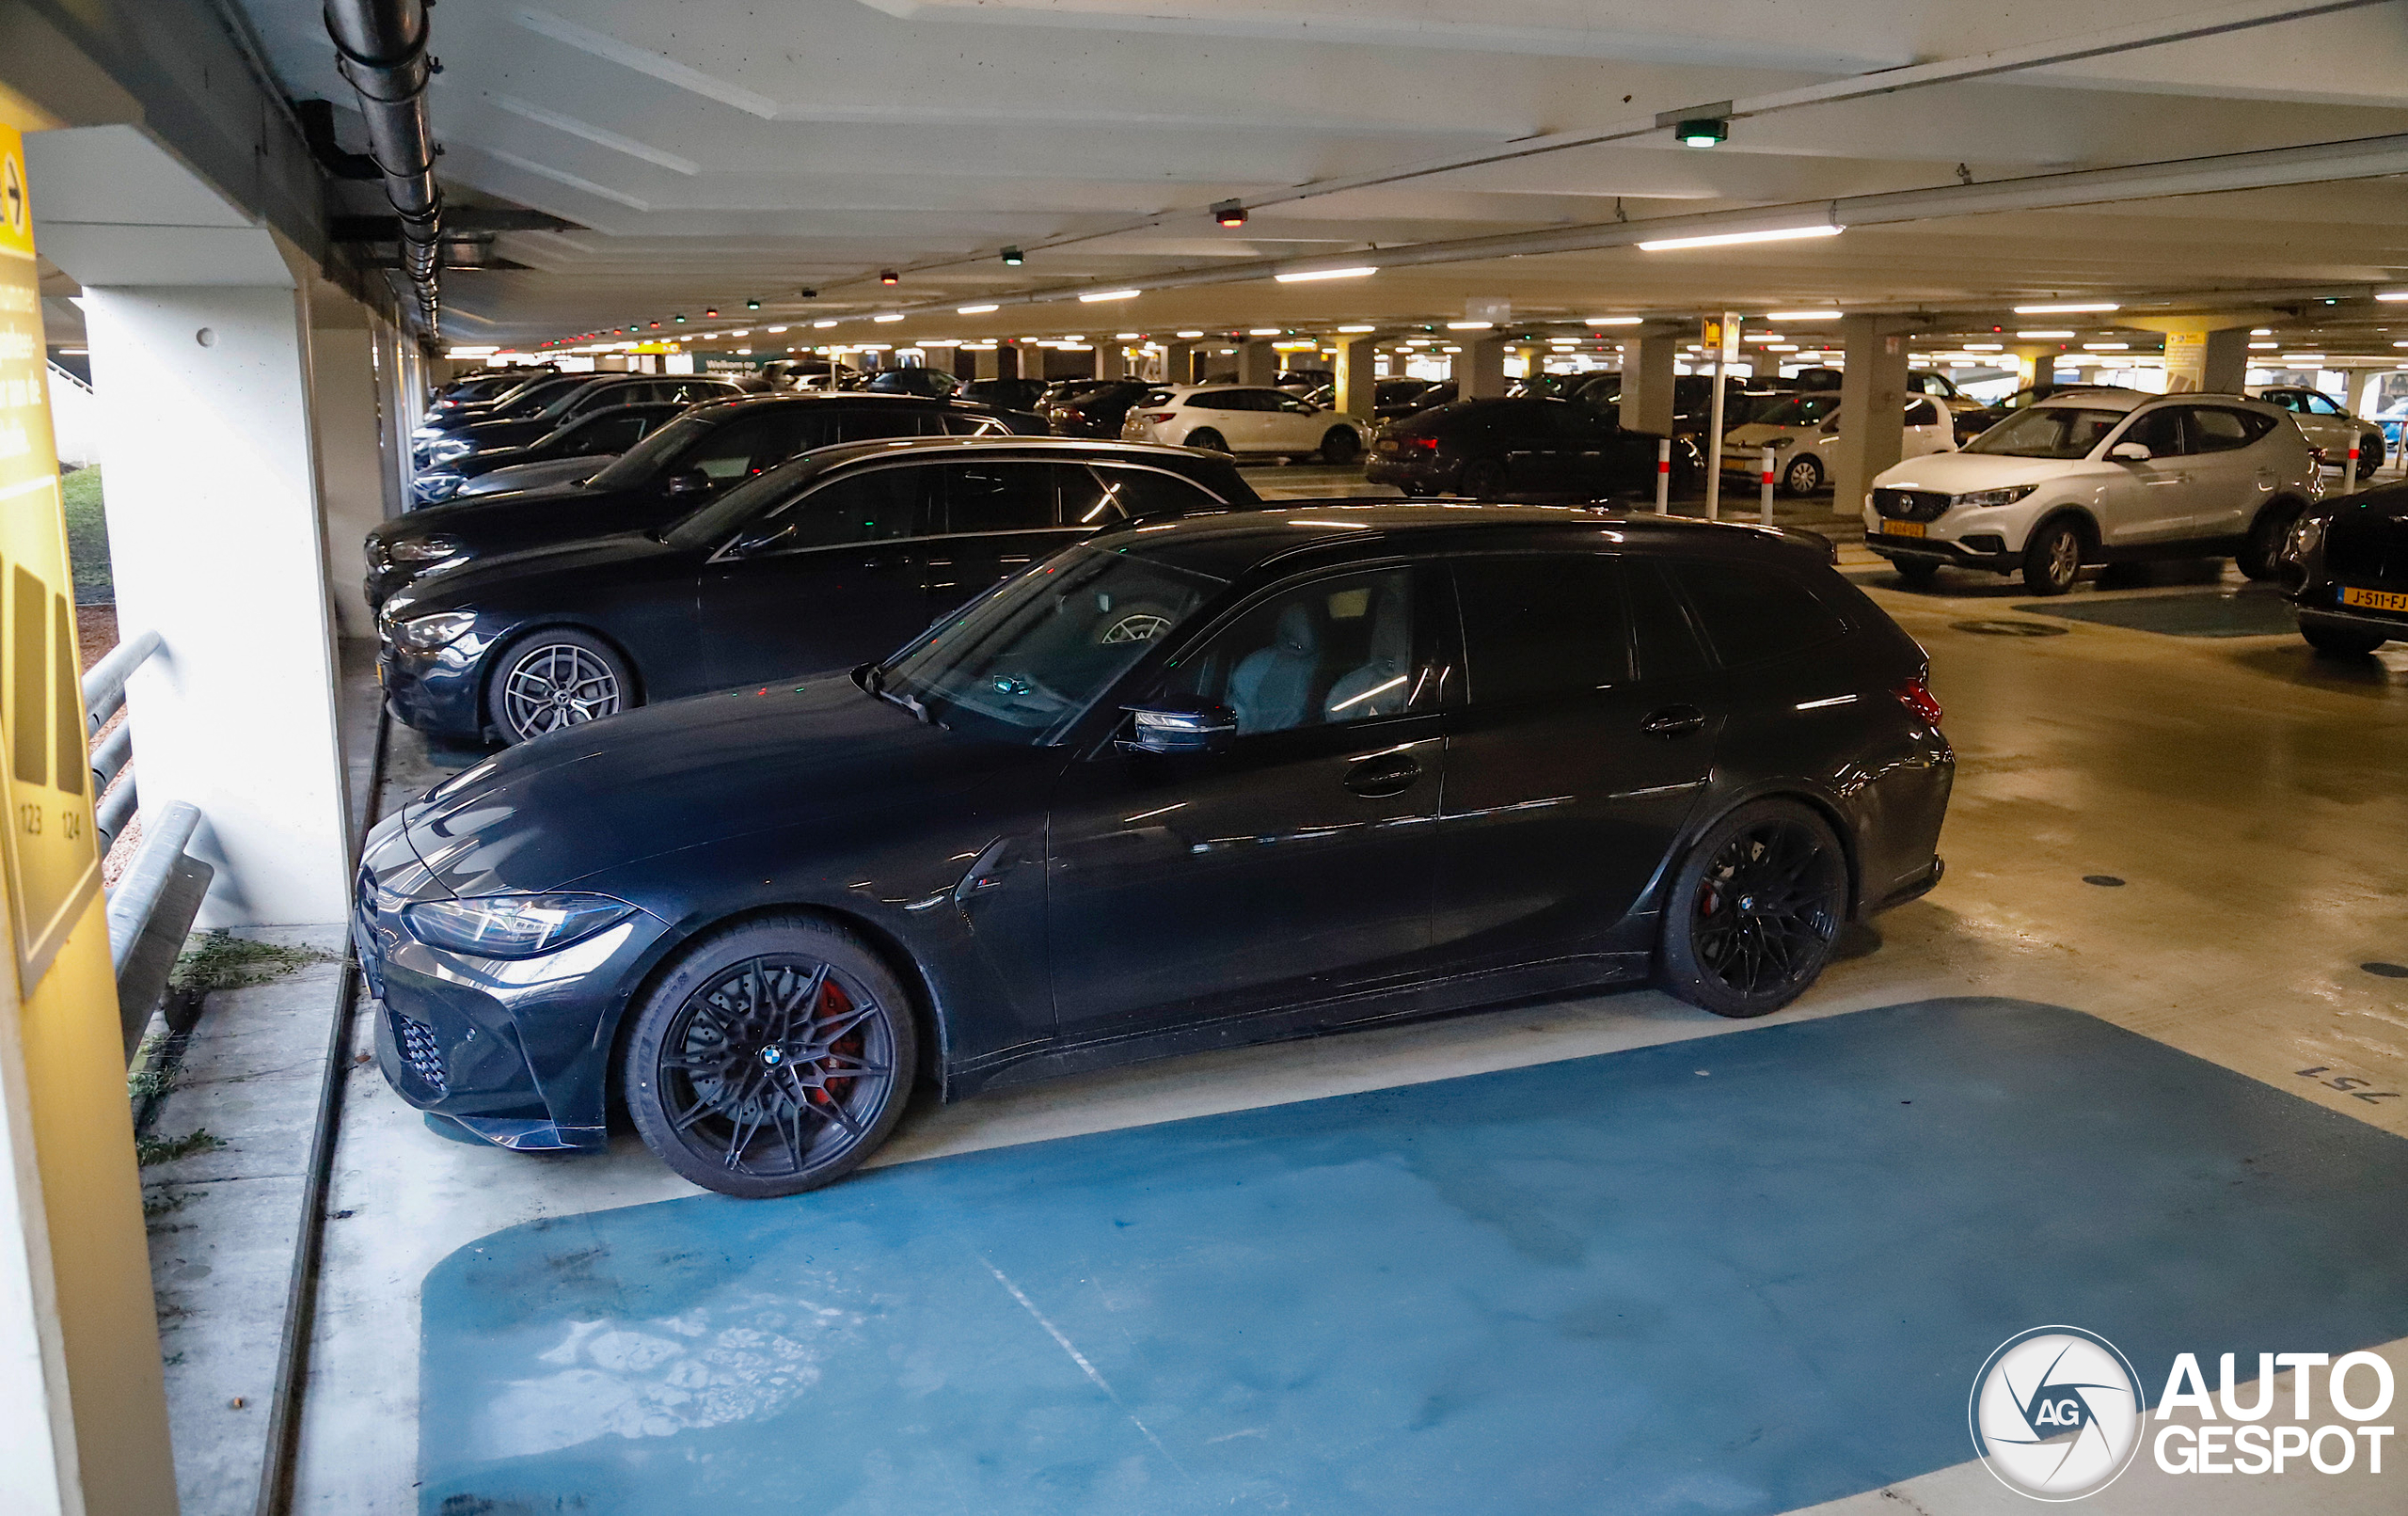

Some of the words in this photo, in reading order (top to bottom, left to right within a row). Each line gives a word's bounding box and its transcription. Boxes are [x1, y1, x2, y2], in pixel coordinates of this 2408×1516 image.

[706, 359, 743, 370] Welkom
[744, 362, 756, 371] op
[2353, 591, 2406, 608] J-511-FJ
[21, 804, 42, 835] 123
[62, 812, 80, 839] 124
